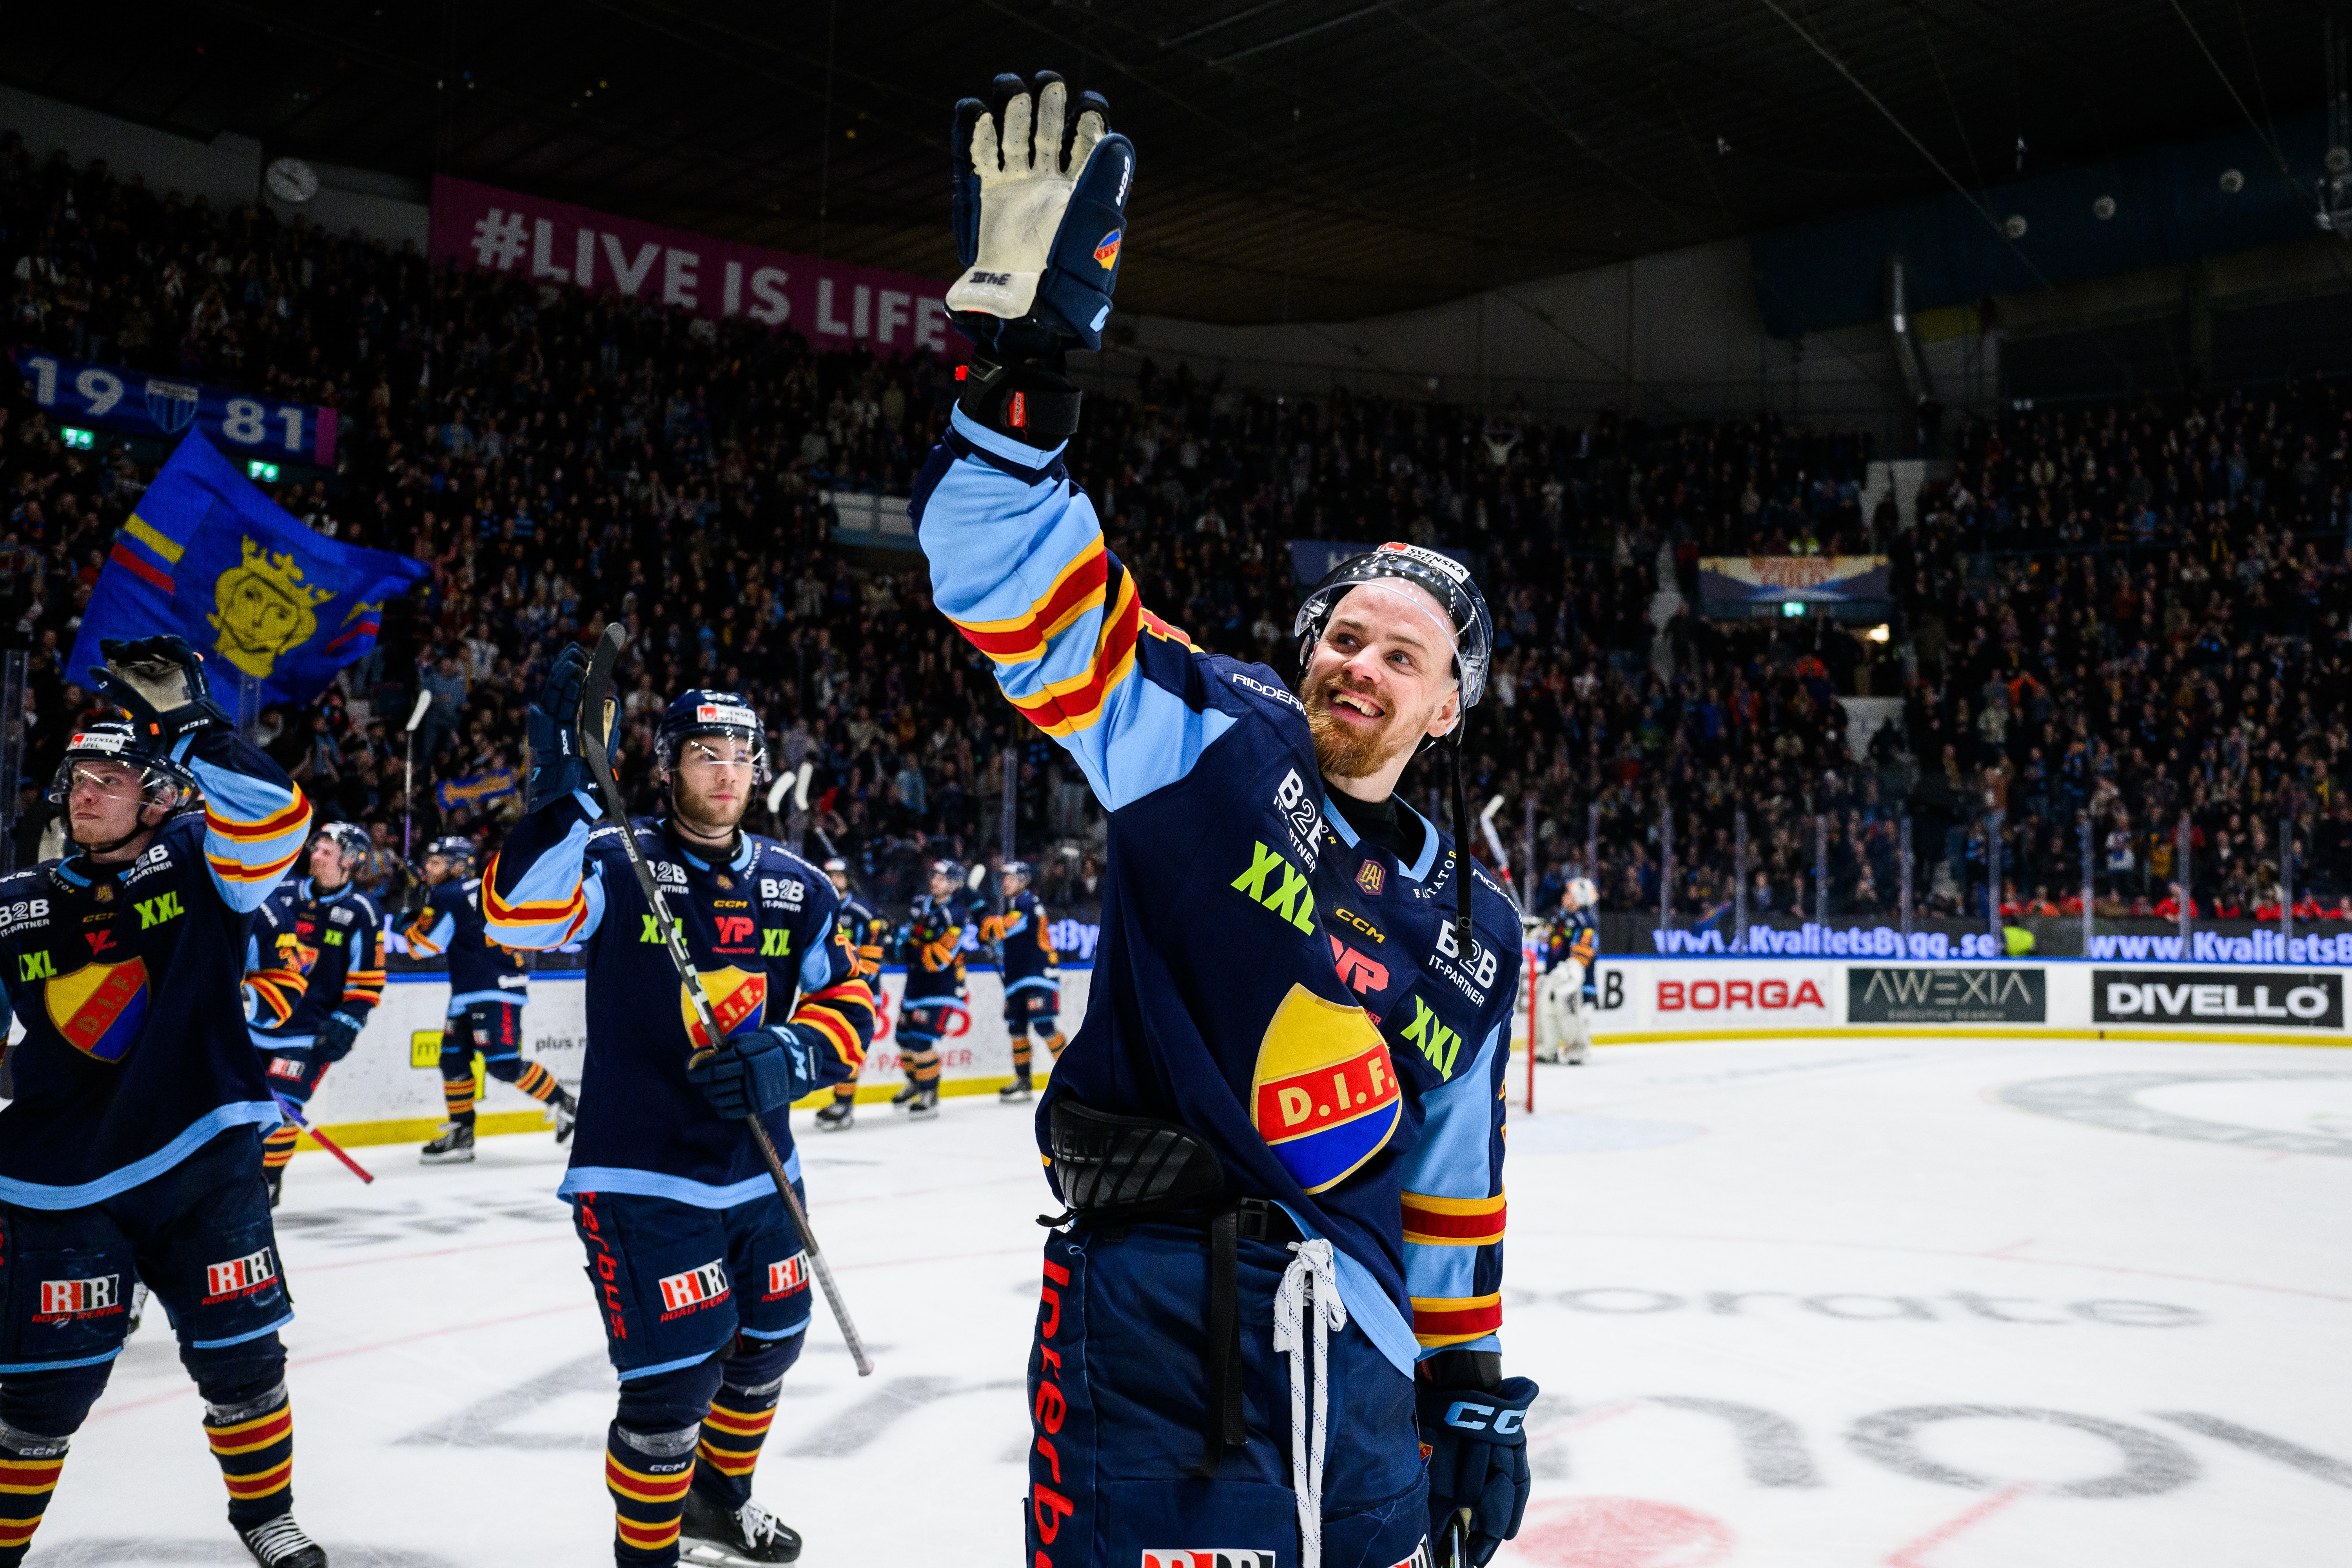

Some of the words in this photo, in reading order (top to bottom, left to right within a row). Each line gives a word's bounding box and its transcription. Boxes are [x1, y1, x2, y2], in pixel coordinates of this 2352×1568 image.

[1116, 156, 1132, 207] CCM
[471, 208, 700, 309] #LIVE
[723, 260, 790, 325] IS
[817, 279, 946, 352] LIFE
[1408, 548, 1464, 577] SVENSKA
[713, 900, 748, 908] CCM
[760, 878, 805, 902] B2B
[1231, 840, 1315, 936] XXL
[133, 891, 185, 930] XXL
[1335, 908, 1385, 944] CCM
[1436, 919, 1497, 989] B2B
[1428, 954, 1485, 1008] IT-PARTNER
[1657, 981, 1825, 1011] BORGA
[1863, 969, 2032, 1006] AWEXIA
[75, 974, 138, 1036] D.I.F.
[2107, 982, 2329, 1020] DIVELLO
[535, 1034, 573, 1053] plus
[1400, 994, 1462, 1081] XXL
[1277, 1057, 1396, 1127] D.I.F.
[32, 1313, 74, 1324] ROAD
[76, 1304, 124, 1321] RENTAL
[202, 1294, 238, 1306] ROAD
[660, 1304, 697, 1323] ROAD
[19, 1446, 59, 1457] CCM
[650, 1461, 687, 1473] CCM
